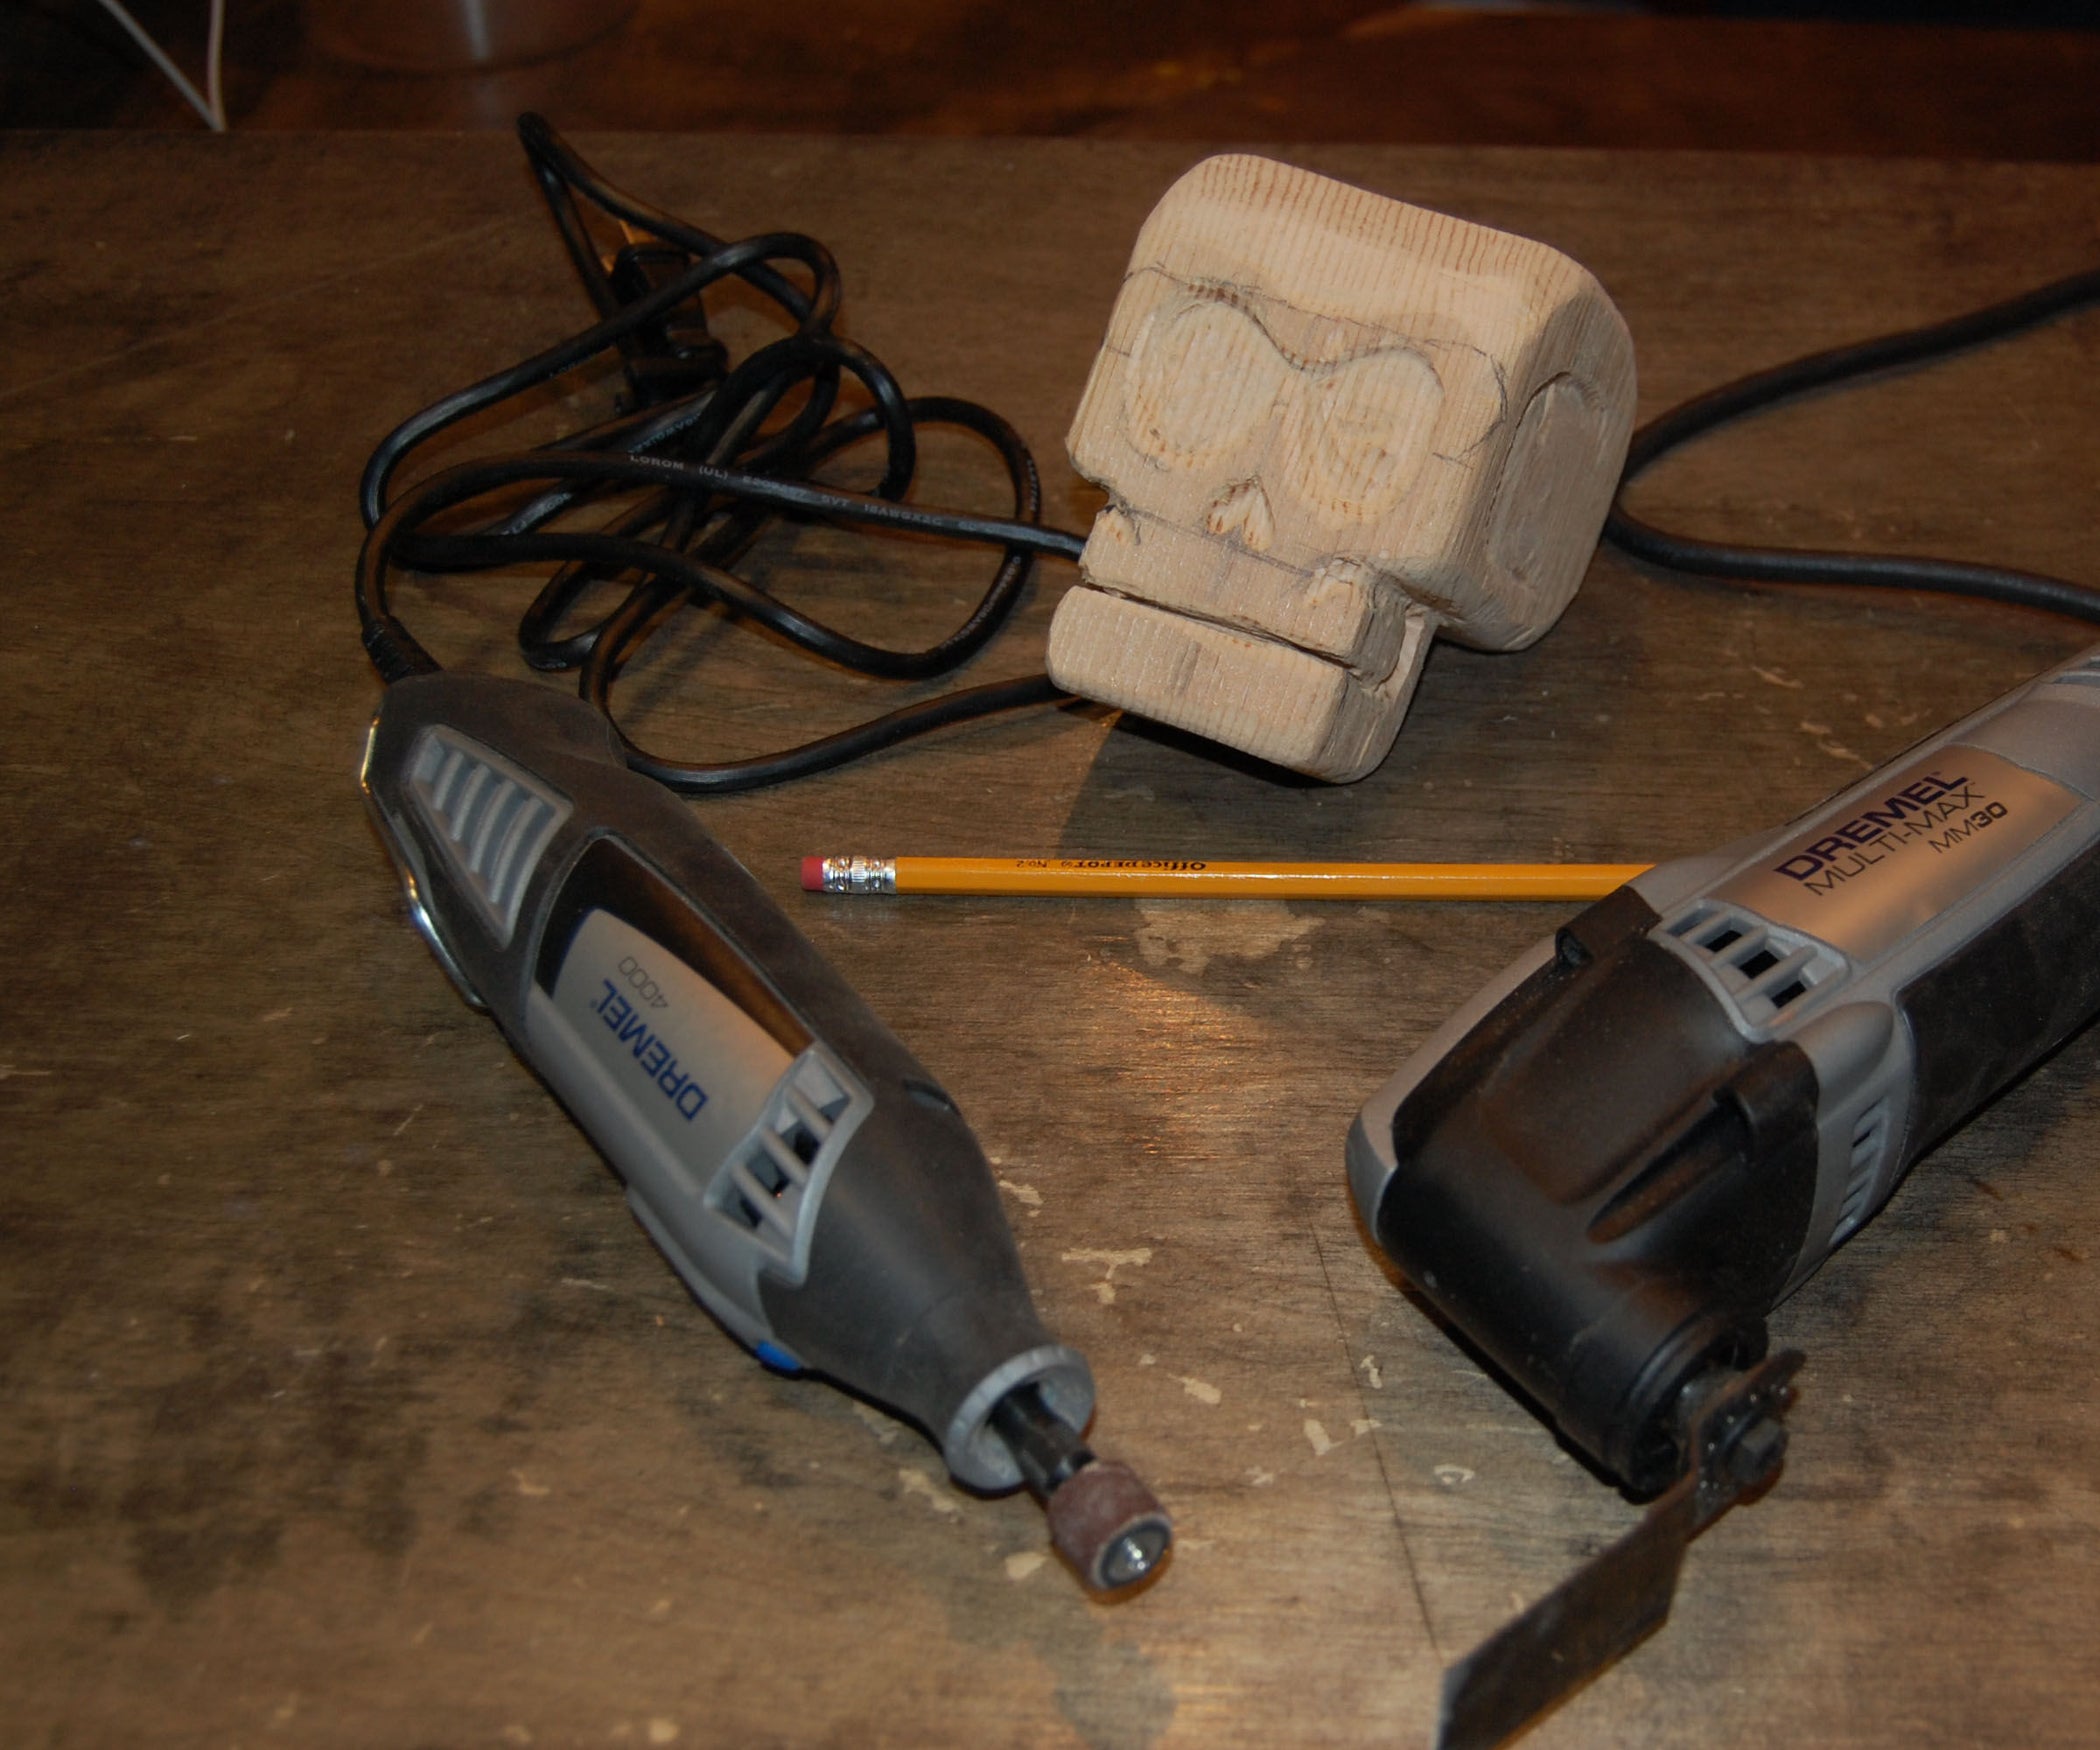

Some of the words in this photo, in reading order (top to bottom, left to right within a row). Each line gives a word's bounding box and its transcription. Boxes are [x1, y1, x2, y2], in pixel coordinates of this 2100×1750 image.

[1773, 776, 1969, 881] DREMEL
[1803, 785, 1985, 896] MULTI-MAX
[1928, 801, 2009, 853] MM30
[618, 955, 669, 1009] 4000
[596, 978, 709, 1121] DREMEL
